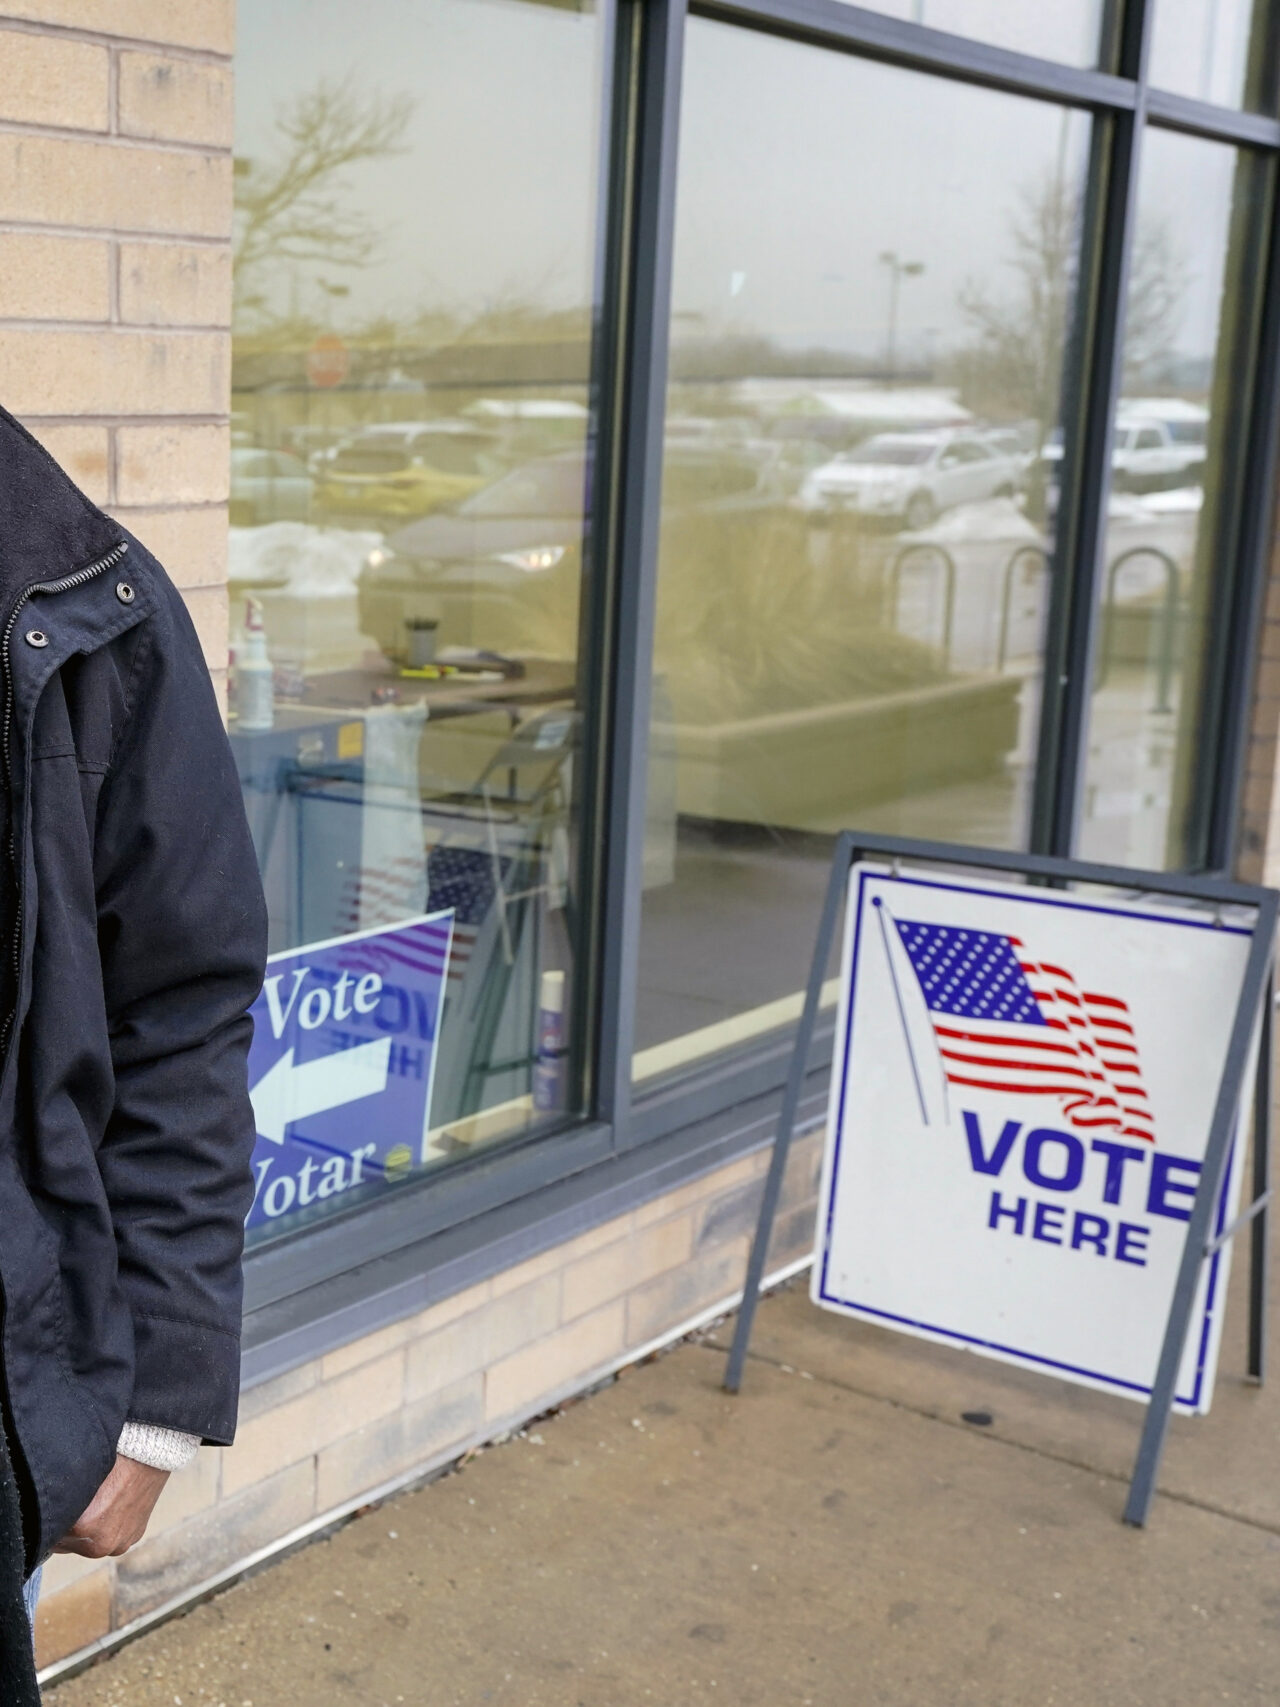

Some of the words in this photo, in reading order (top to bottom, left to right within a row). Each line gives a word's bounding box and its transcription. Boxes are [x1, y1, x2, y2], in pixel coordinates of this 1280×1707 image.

[263, 966, 383, 1040] Vote
[961, 1109, 1203, 1222] VOTE
[987, 1189, 1151, 1267] HERE
